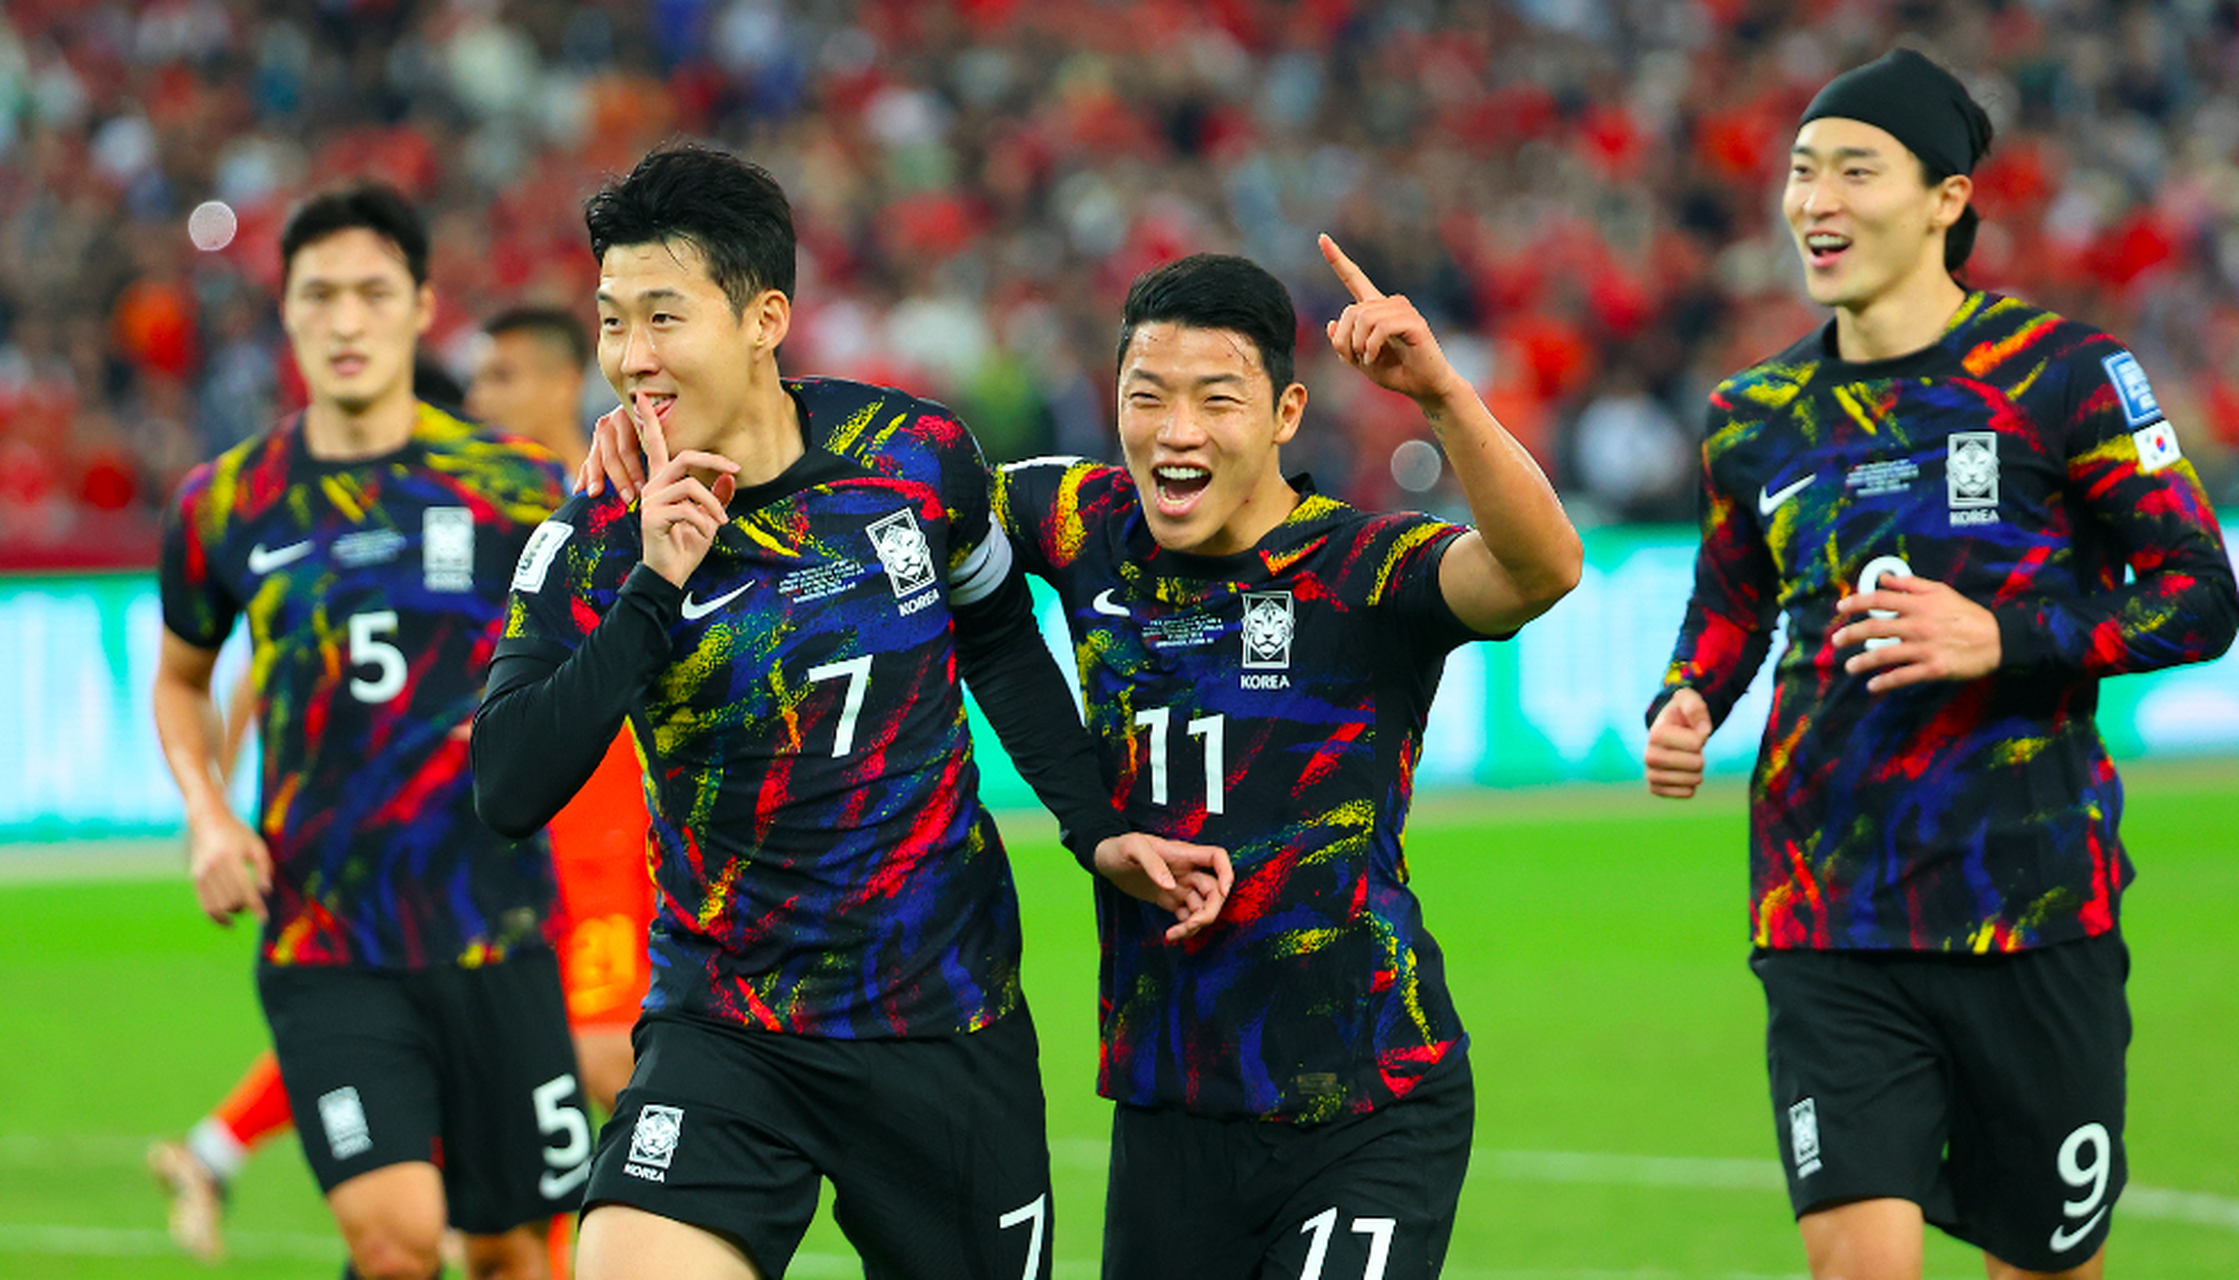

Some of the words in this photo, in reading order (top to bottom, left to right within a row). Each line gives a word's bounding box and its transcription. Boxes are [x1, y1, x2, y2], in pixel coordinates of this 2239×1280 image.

[898, 588, 940, 617] KOREA
[349, 611, 408, 703] 5
[1240, 674, 1291, 690] KOREA
[807, 654, 874, 758] 7
[1134, 706, 1224, 815] 11
[534, 1074, 590, 1168] 5
[623, 1163, 665, 1183] KOREA
[2057, 1122, 2111, 1218] 9
[999, 1193, 1046, 1280] 7
[1299, 1207, 1398, 1280] 11
